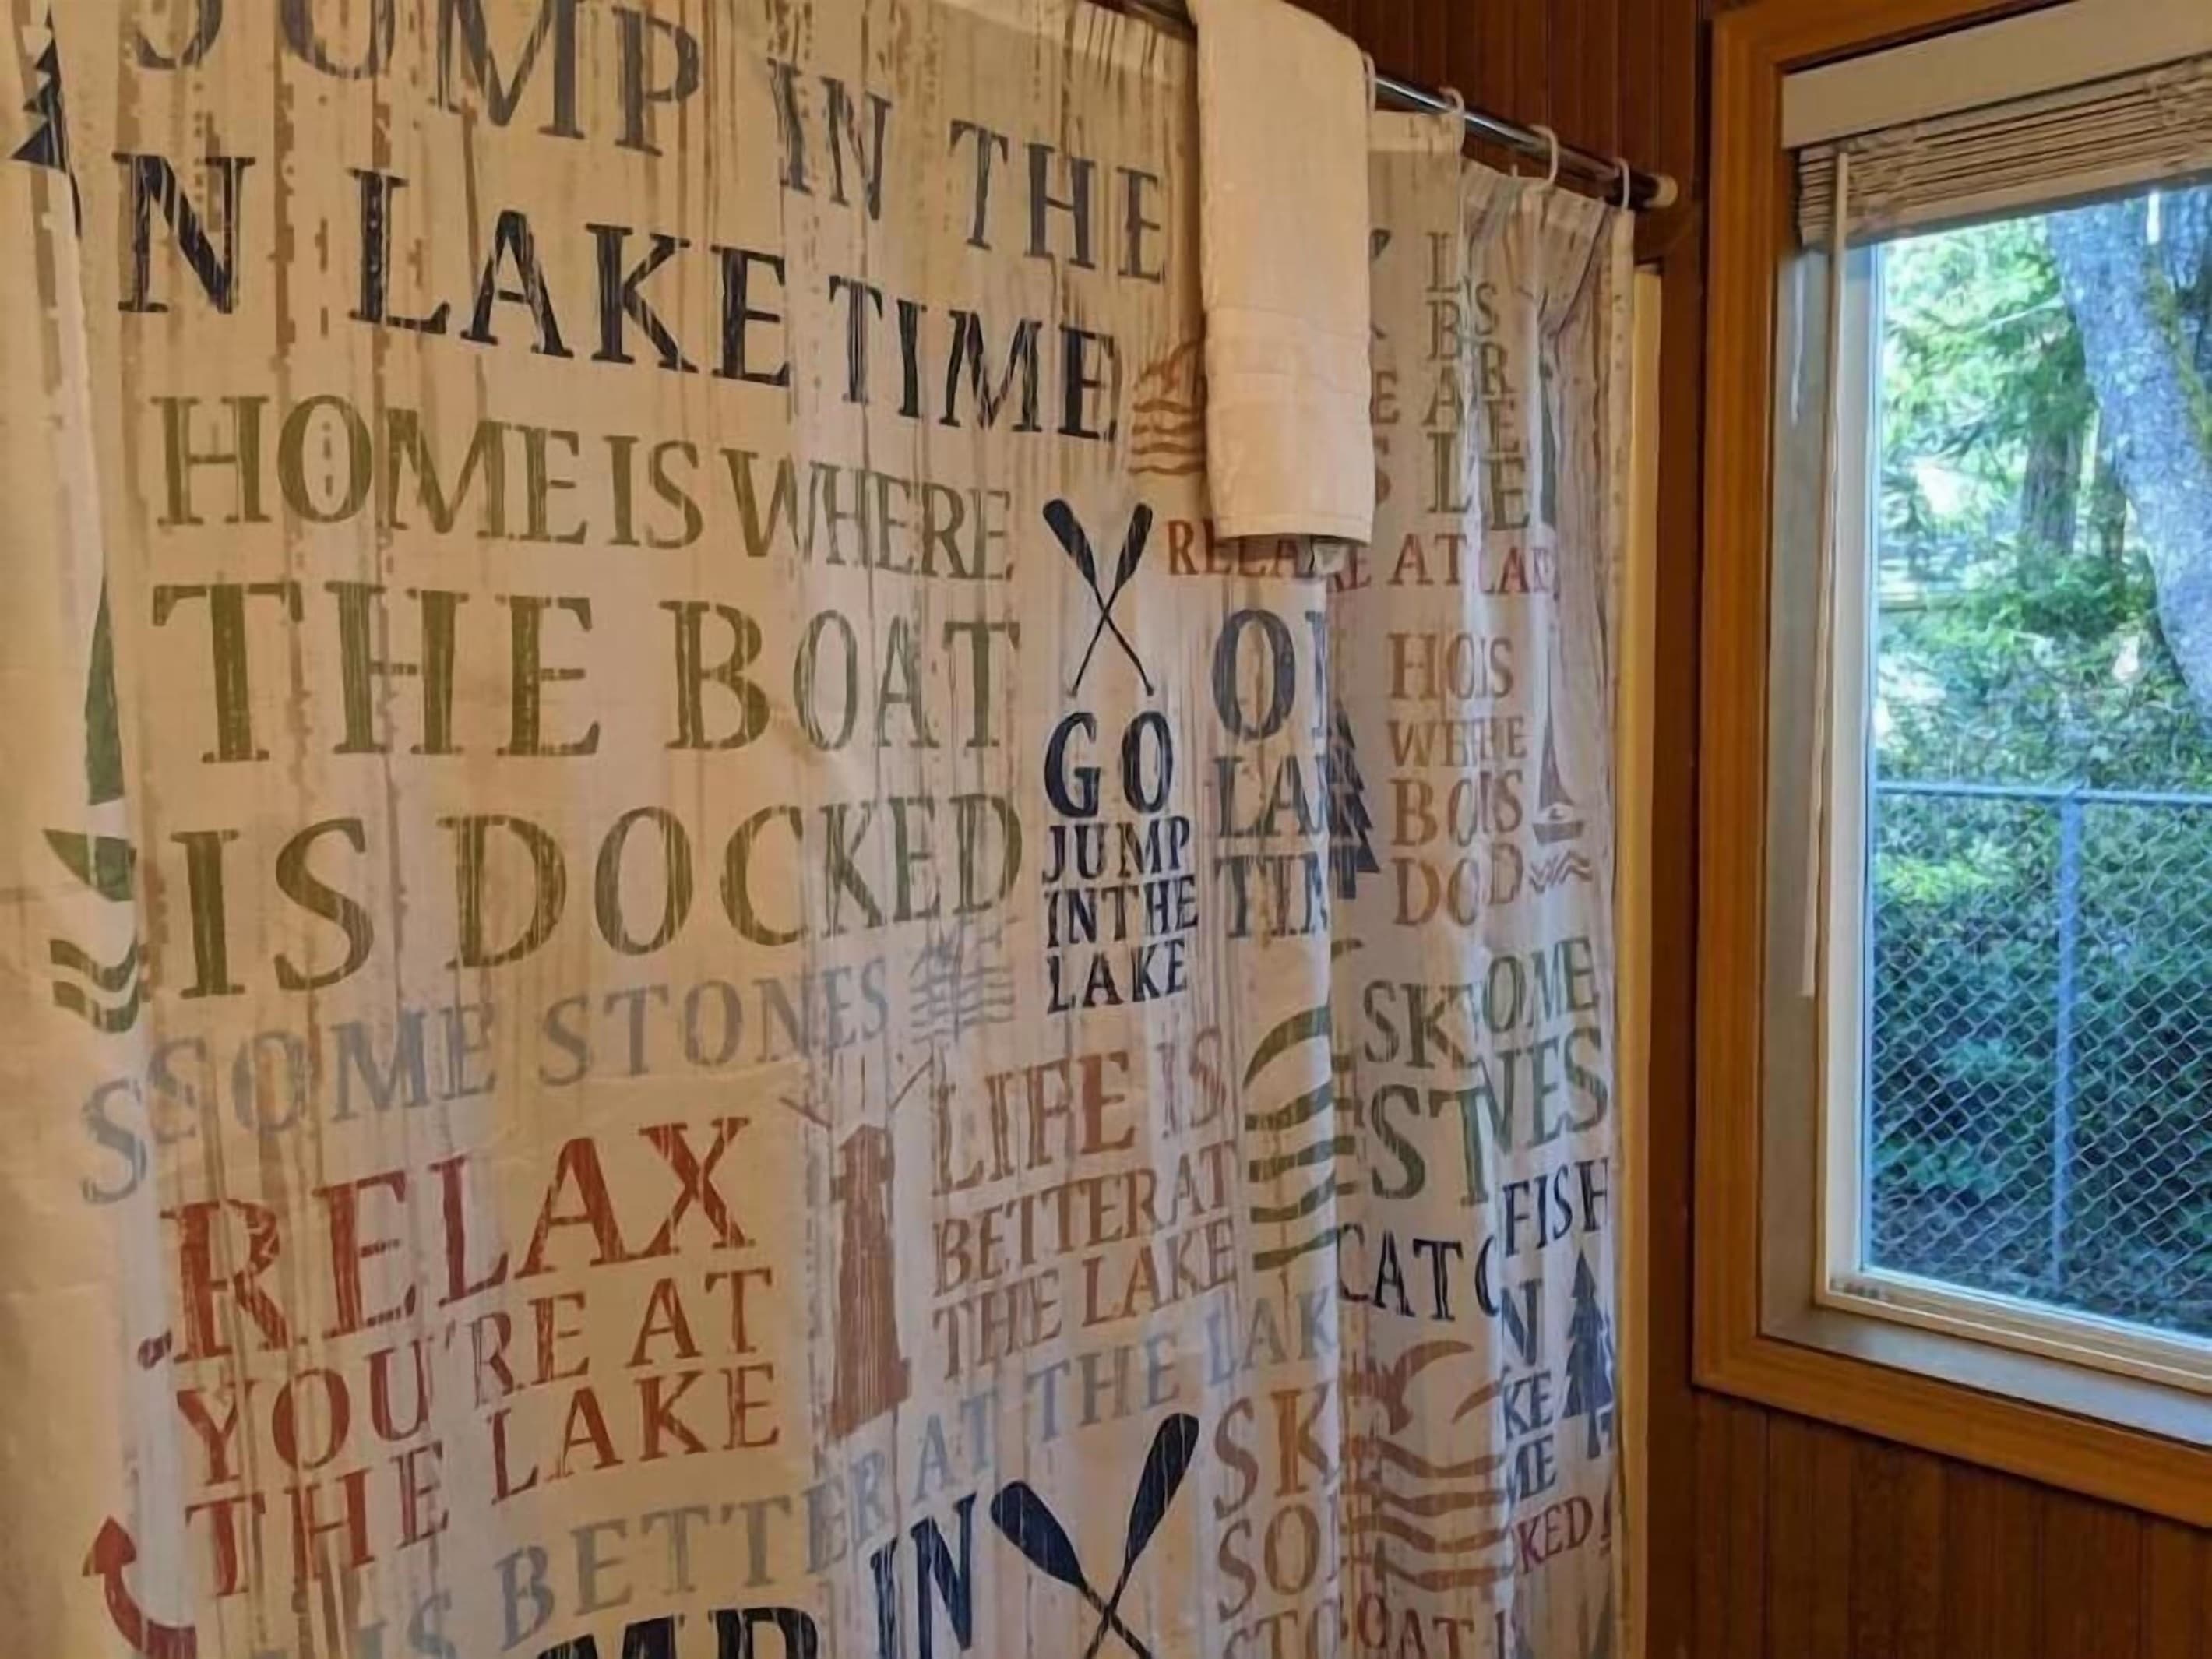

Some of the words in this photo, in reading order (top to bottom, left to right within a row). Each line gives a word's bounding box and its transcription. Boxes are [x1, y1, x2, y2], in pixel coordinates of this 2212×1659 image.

[767, 58, 893, 221] IN
[949, 118, 1166, 284] THE
[347, 167, 791, 388] LAKE
[829, 274, 1124, 442] TIME
[150, 393, 589, 546] HOME
[602, 434, 704, 550] IS
[720, 447, 1014, 582] WHERE
[153, 580, 601, 763] THE
[659, 600, 1021, 752] BOAT
[1043, 712, 1174, 819] GO
[169, 818, 376, 999] IS
[436, 794, 1023, 971] DOCKED
[1041, 815, 1191, 883] JUMP
[146, 1003, 498, 1145] SOME
[539, 953, 889, 1087] STONES
[1045, 941, 1188, 1016] LAKE
[933, 1051, 1138, 1197] LIFE
[1156, 1026, 1227, 1139] IS
[160, 1117, 756, 1364] RELAX
[933, 1168, 1172, 1298] BETTER
[1168, 1139, 1238, 1227] AT
[933, 1268, 1062, 1381] THE
[1080, 1216, 1238, 1327] LAKE
[176, 1290, 590, 1487] YOU'RE
[625, 1268, 773, 1368] AT
[185, 1441, 450, 1598] THE
[486, 1365, 780, 1505] LAKE
[495, 1450, 893, 1650] BETTER
[913, 1390, 1000, 1506] AT
[1023, 1332, 1180, 1442] THE
[870, 1492, 977, 1659] IN
